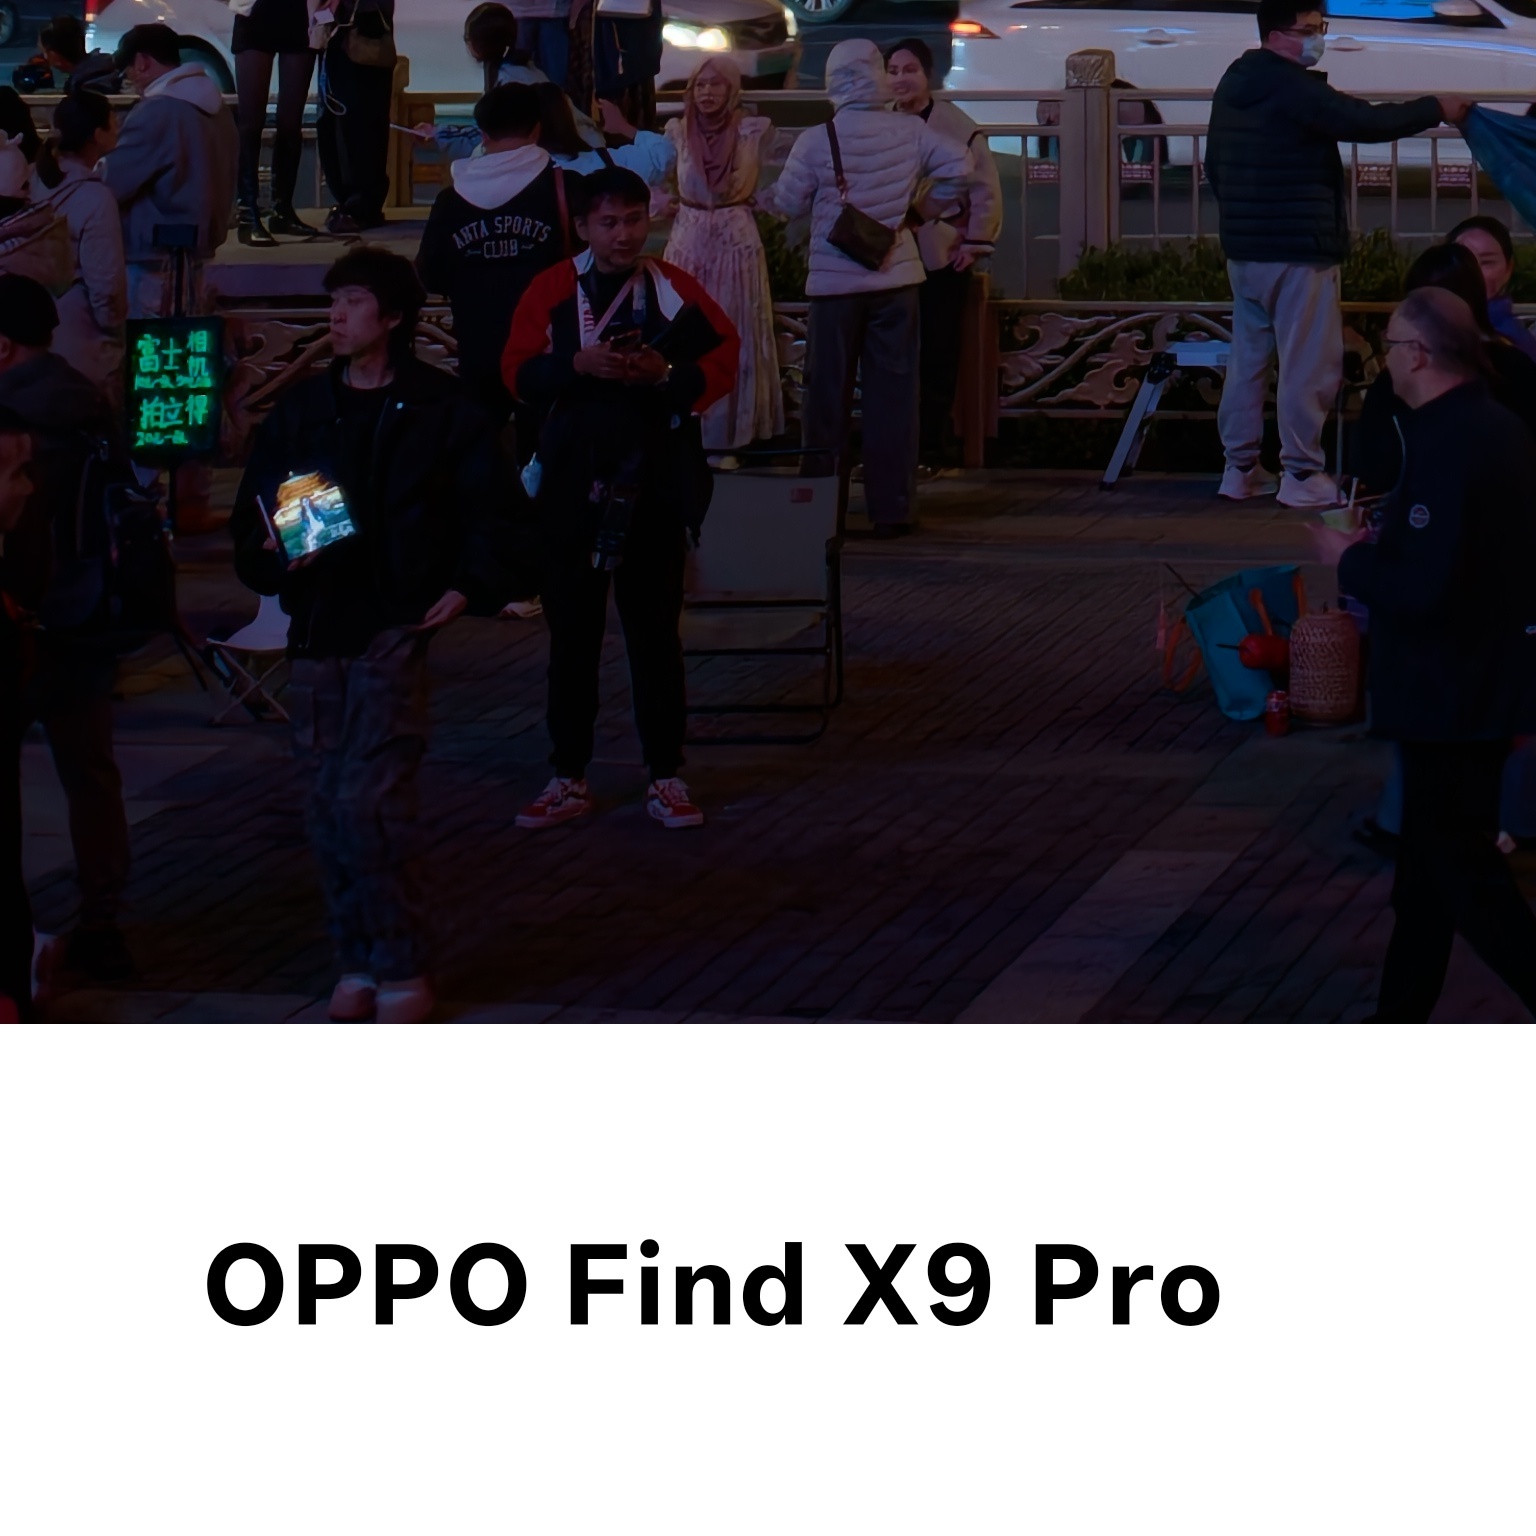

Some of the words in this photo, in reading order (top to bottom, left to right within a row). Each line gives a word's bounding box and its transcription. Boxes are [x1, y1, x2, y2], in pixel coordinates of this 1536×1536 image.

[494, 215, 552, 243] SPORTS
[483, 238, 520, 259] CLUB
[139, 394, 209, 430] 拍立得
